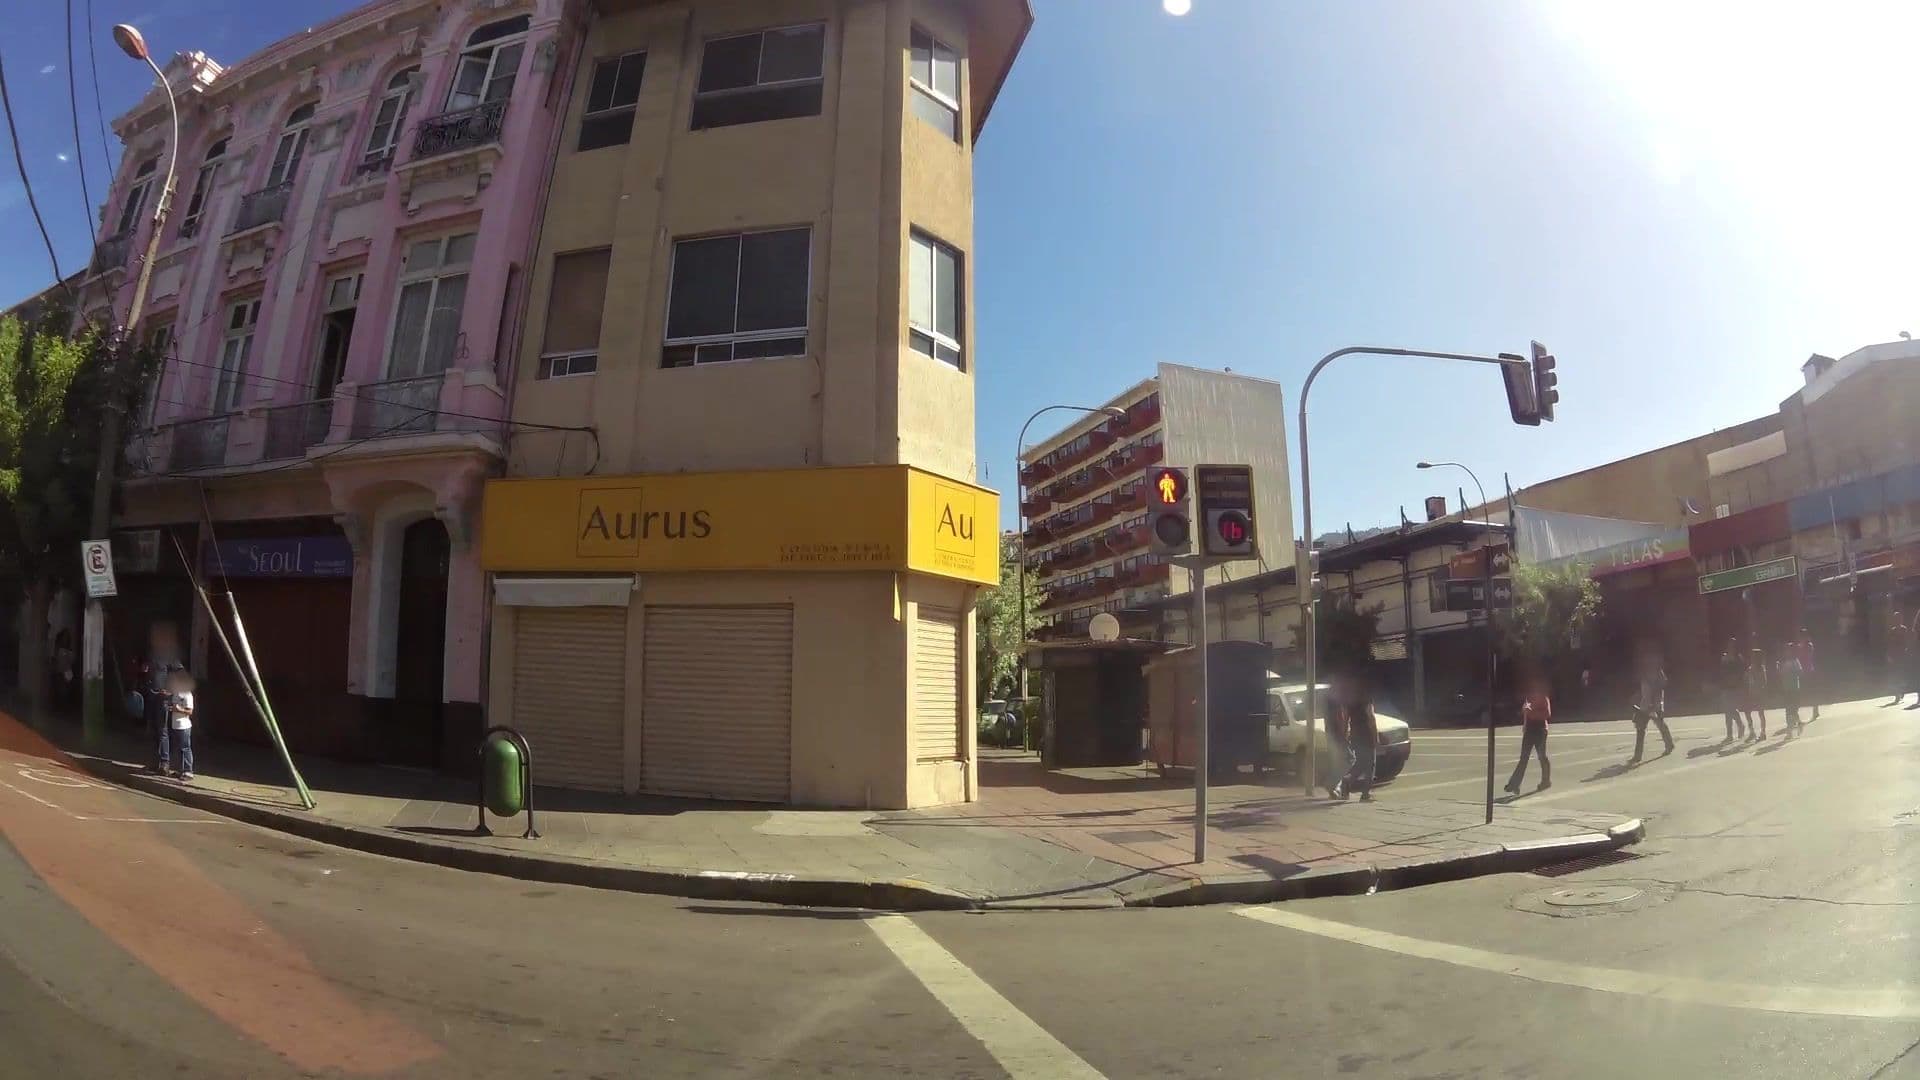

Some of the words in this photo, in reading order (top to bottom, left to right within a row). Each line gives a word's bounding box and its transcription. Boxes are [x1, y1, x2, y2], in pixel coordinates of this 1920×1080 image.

[583, 505, 712, 540] Aurus
[937, 502, 974, 541] Au
[1609, 538, 1665, 567] TELAS
